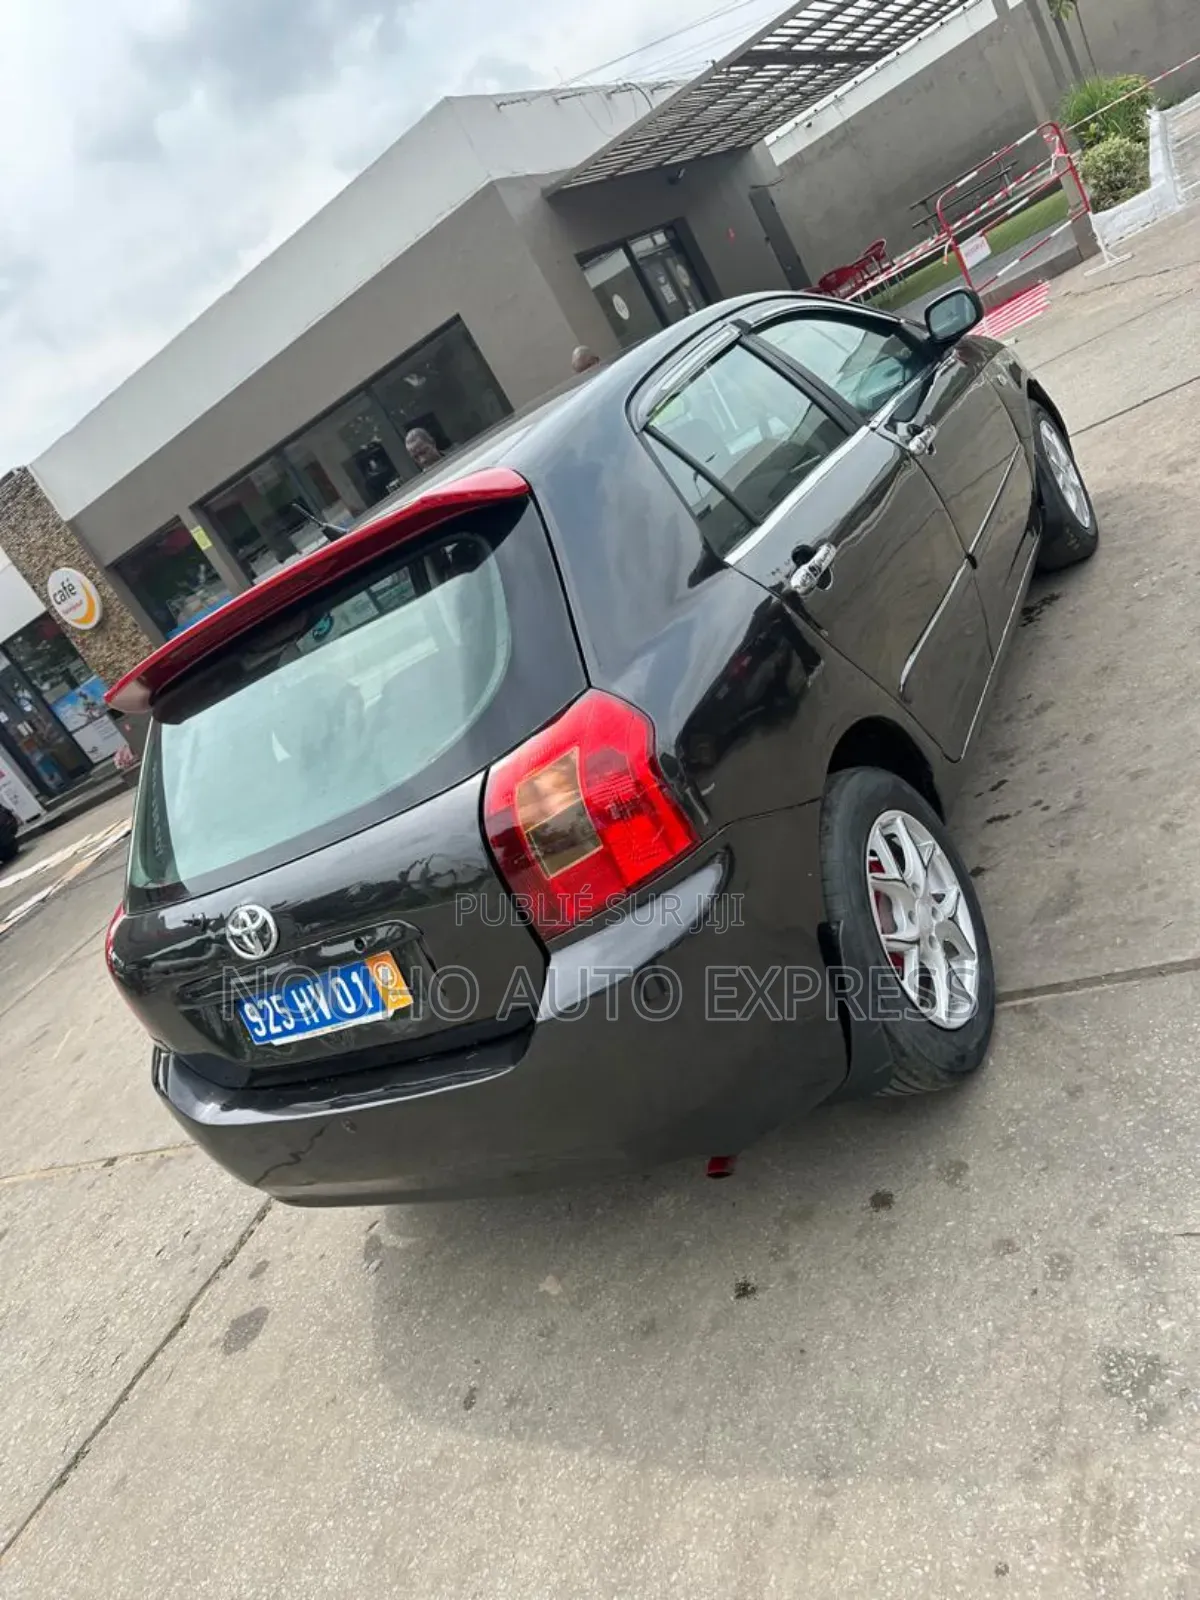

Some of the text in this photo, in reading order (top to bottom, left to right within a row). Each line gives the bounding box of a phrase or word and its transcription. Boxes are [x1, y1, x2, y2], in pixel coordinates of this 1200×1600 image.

[52, 577, 77, 605] café
[244, 971, 374, 1037] 925 HV 01
